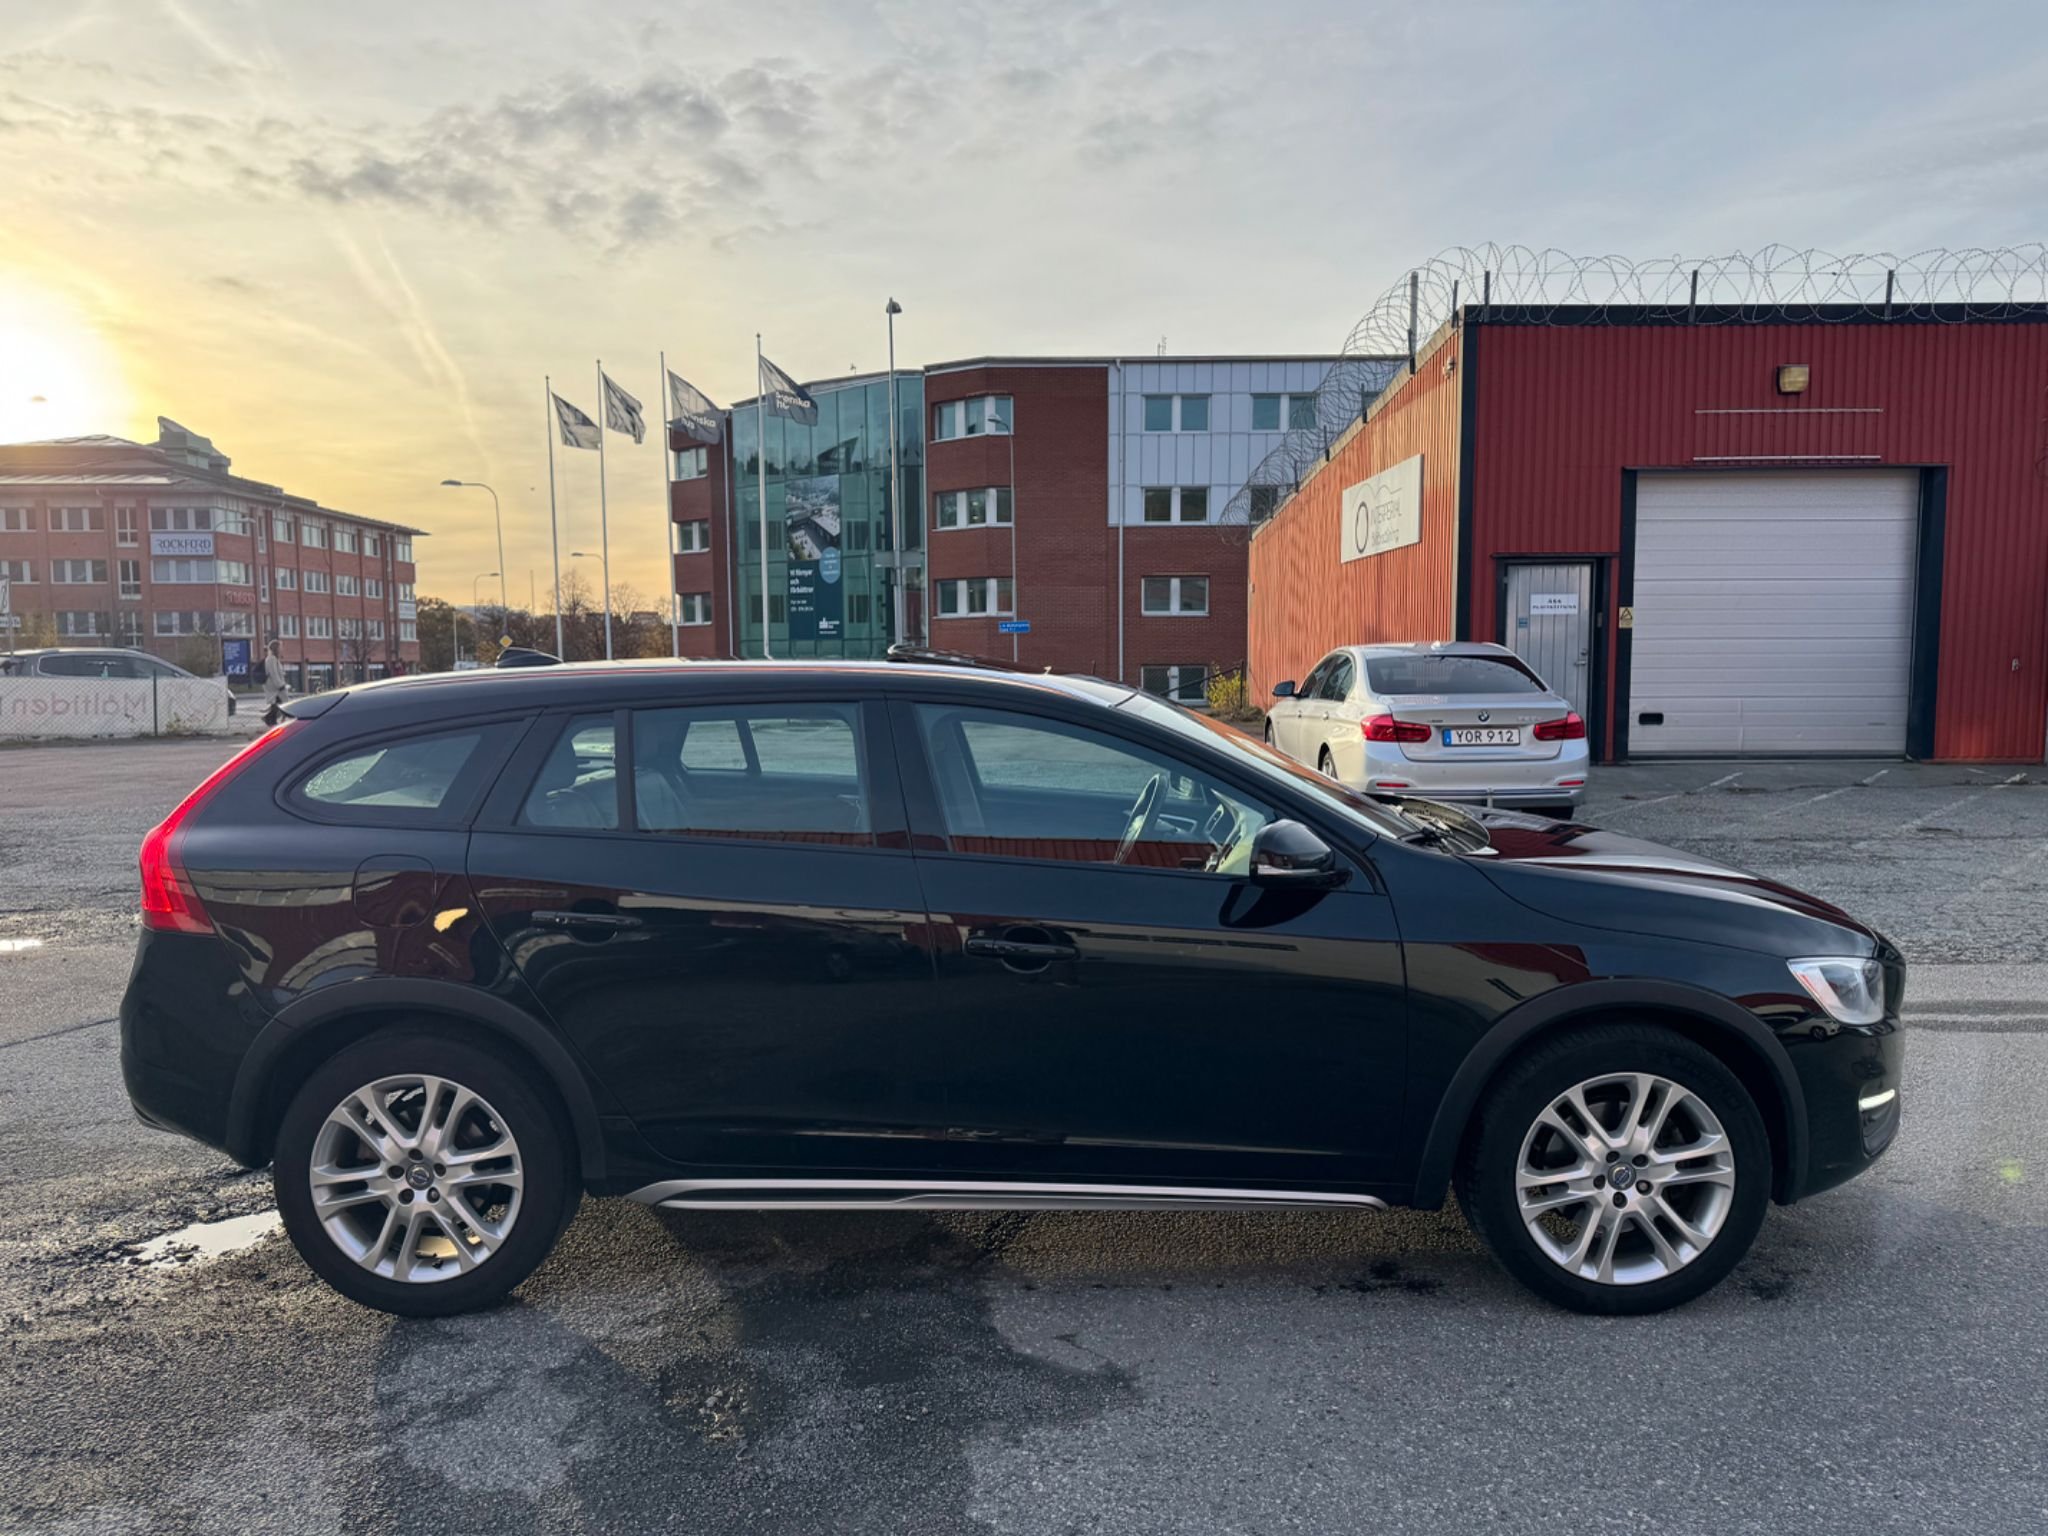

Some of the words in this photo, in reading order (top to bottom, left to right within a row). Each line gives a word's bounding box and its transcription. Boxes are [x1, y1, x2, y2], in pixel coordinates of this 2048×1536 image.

[155, 538, 211, 549] ROCKFORD
[226, 663, 248, 675] SAS
[1456, 730, 1482, 742] YOR
[1487, 730, 1514, 742] 912
